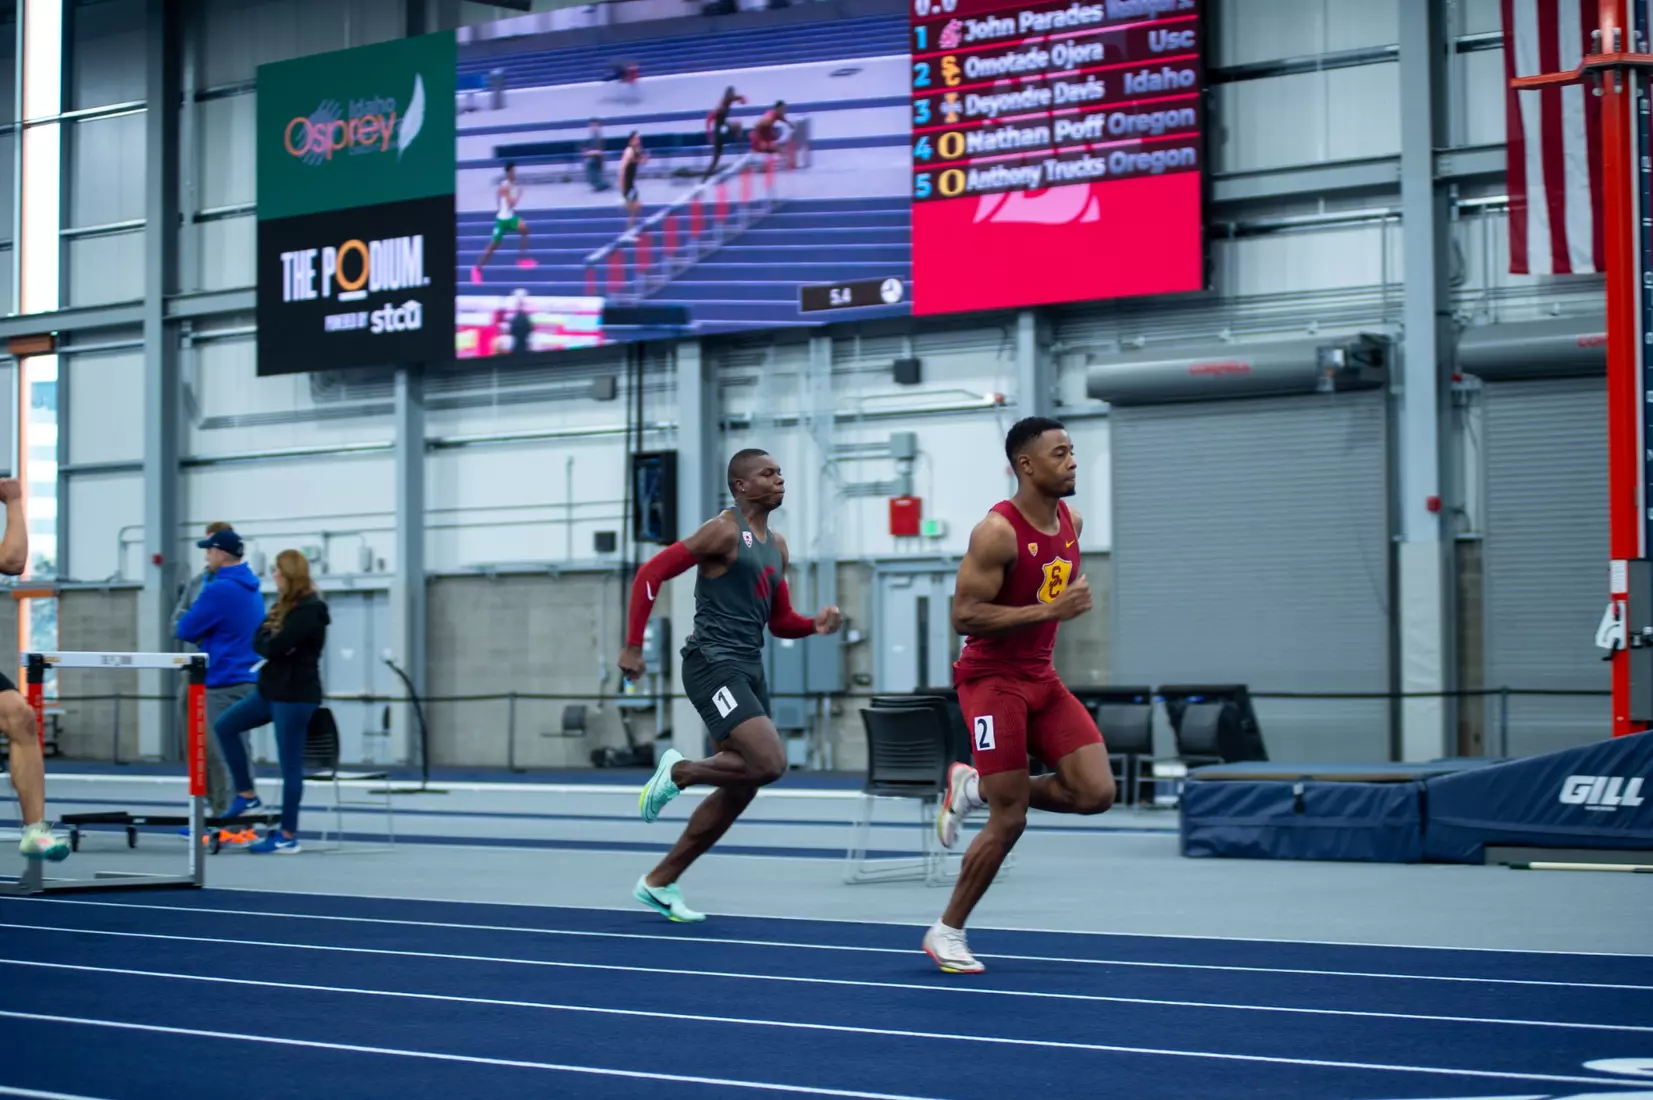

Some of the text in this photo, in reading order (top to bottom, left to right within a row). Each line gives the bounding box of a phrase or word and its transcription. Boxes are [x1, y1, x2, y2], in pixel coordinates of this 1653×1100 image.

[914, 25, 928, 49] 1
[963, 15, 1015, 42] John
[1019, 2, 1104, 33] Parades
[913, 62, 931, 87] 2
[964, 46, 1049, 79] Omotade
[1051, 39, 1104, 70] Ojora
[1148, 29, 1195, 52] Usc
[914, 98, 932, 124] 3
[965, 84, 1052, 117] Deyondre
[1054, 74, 1105, 104] Davis
[1124, 66, 1195, 94] Idaho
[284, 110, 397, 160] Osprey
[913, 135, 934, 160] 4
[966, 125, 1050, 154] Nathan
[1054, 113, 1105, 142] Poff
[1108, 107, 1195, 135] Oregon
[914, 172, 932, 198] 5
[966, 164, 1042, 191] Anthony
[1043, 153, 1106, 181] Trucks
[1108, 146, 1196, 175] Oregon
[280, 248, 318, 302] THE
[1049, 565, 1063, 599] SC
[718, 691, 732, 711] 1
[977, 718, 991, 749] 2
[1559, 775, 1645, 807] GILL
